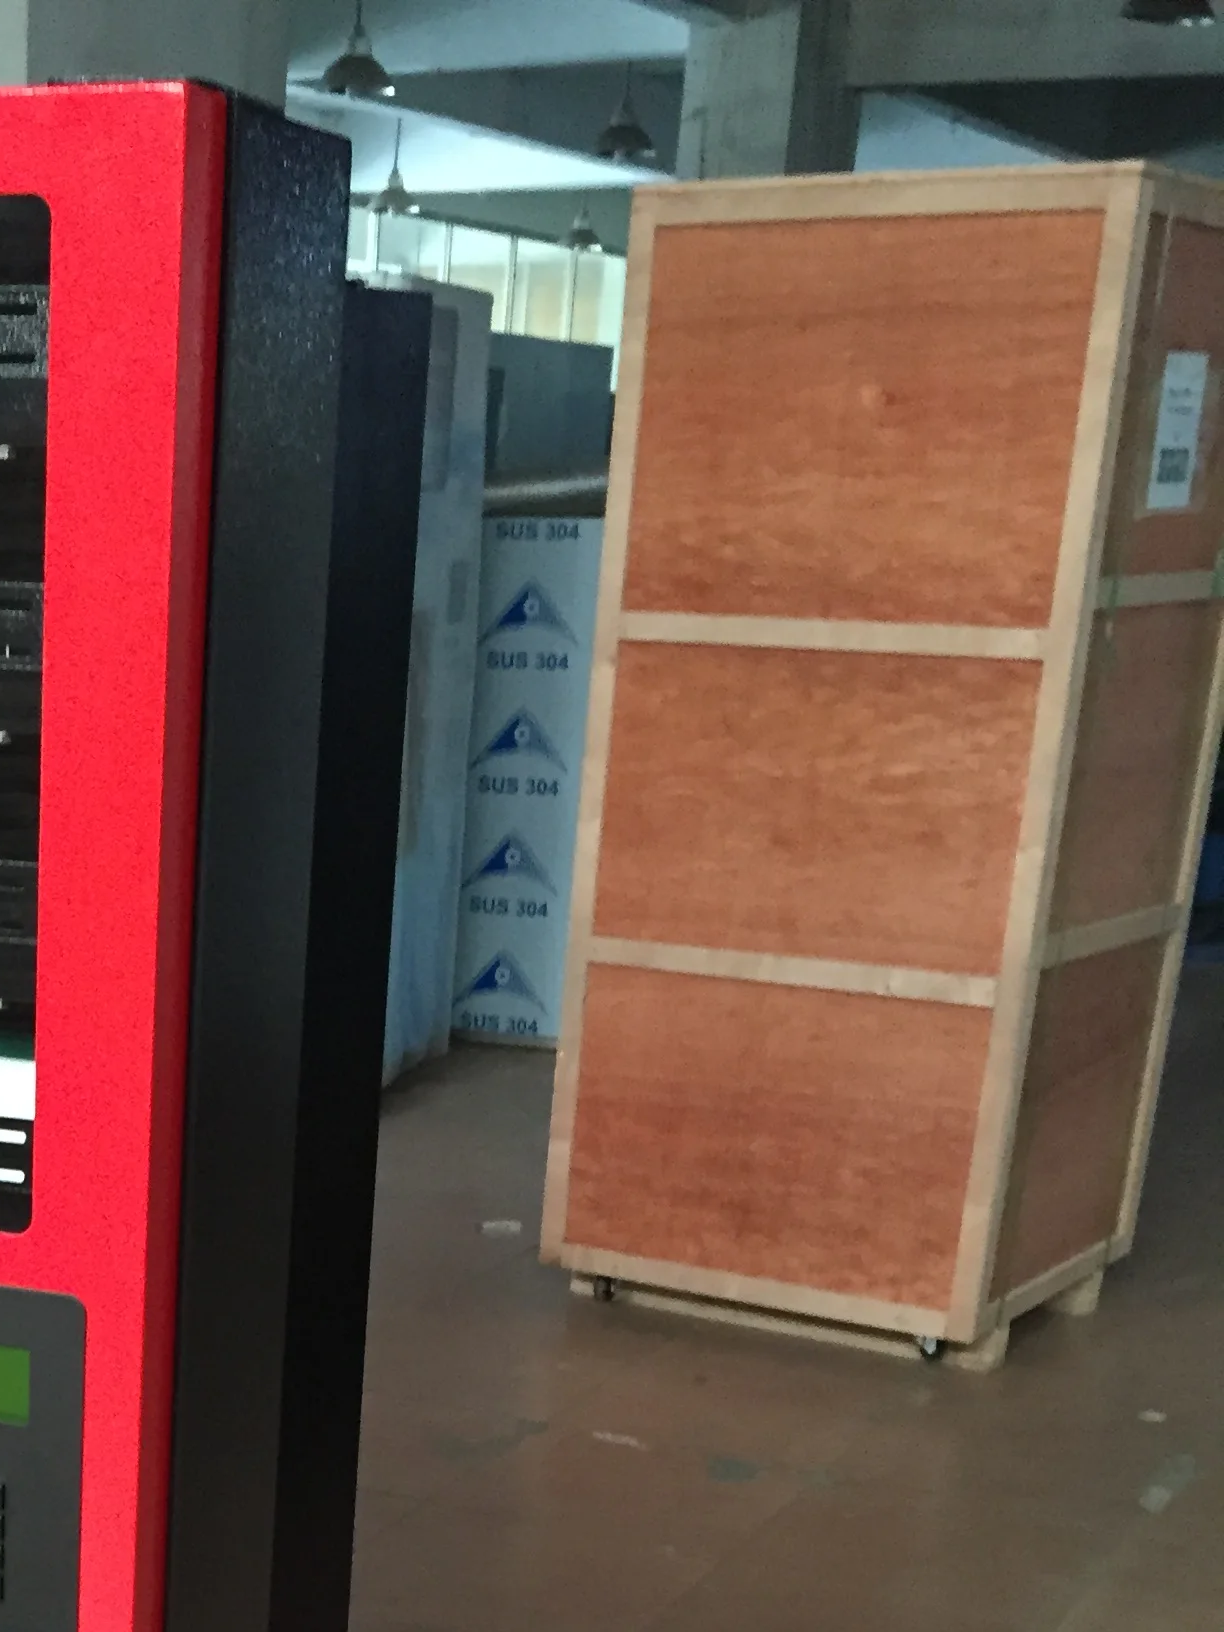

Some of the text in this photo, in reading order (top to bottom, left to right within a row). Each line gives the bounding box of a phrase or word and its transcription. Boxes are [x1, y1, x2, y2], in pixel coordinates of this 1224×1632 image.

[496, 521, 580, 541] SUS 304
[486, 650, 569, 671] SUS 304
[477, 775, 559, 796] SUS 304
[469, 895, 548, 918] SUS 304
[507, 1016, 538, 1034] 304
